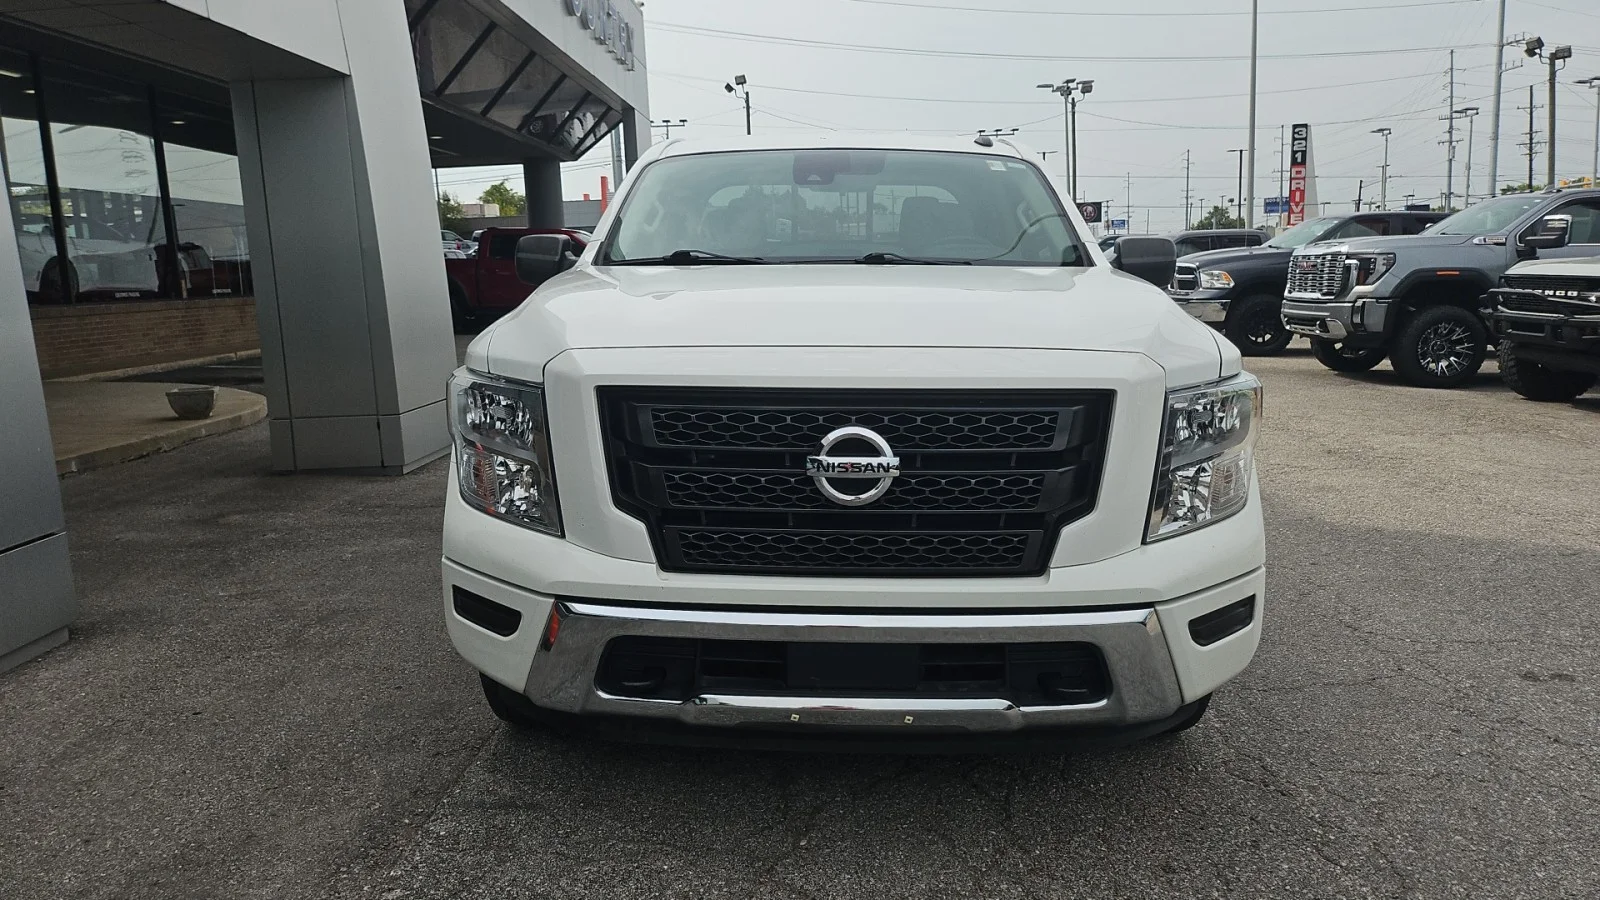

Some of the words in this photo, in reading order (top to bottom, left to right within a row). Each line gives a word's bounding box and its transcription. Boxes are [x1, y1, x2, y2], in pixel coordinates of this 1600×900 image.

[1293, 127, 1307, 163] 321
[1290, 167, 1306, 225] DRIVE
[816, 462, 890, 473] NISSAN
